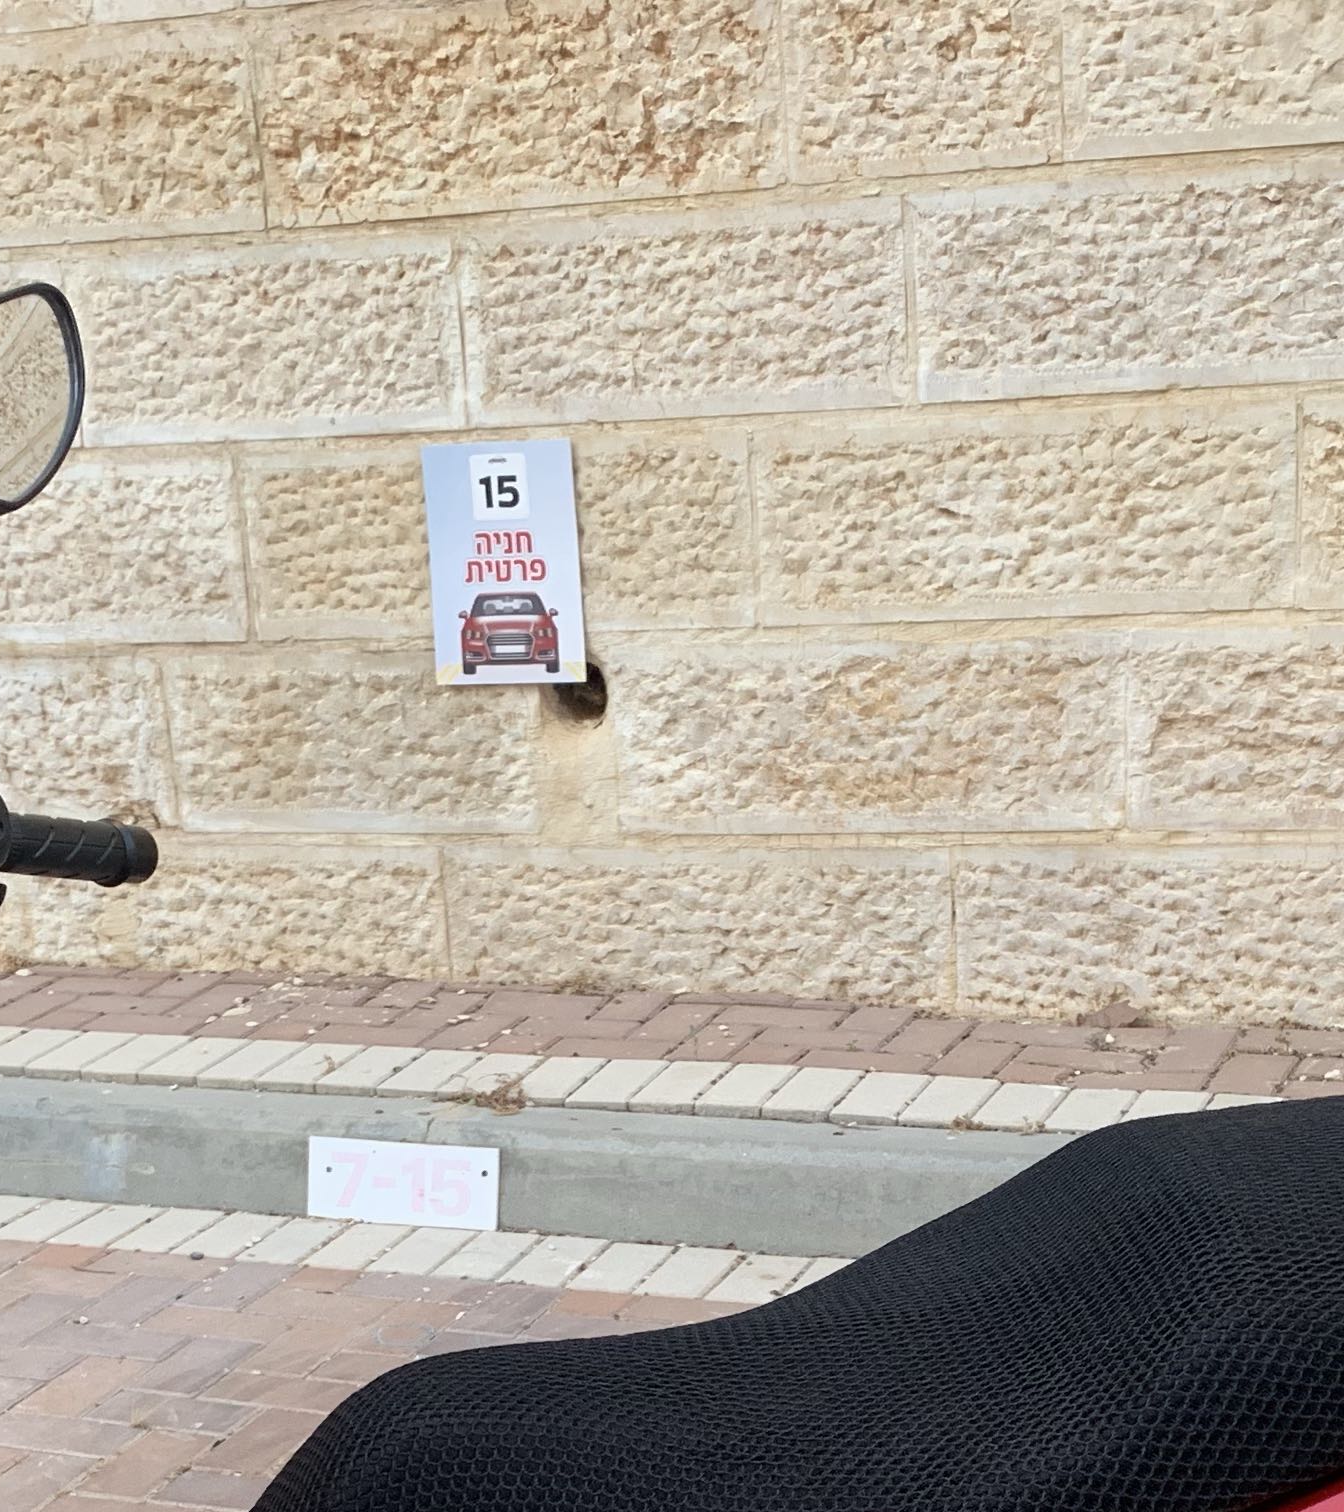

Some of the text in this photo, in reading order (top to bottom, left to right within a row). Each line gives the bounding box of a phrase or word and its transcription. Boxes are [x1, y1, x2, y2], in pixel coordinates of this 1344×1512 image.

[478, 474, 520, 509] 15
[474, 531, 534, 556] חניה
[464, 558, 548, 584] פרטית
[331, 1151, 473, 1217] 7-15
